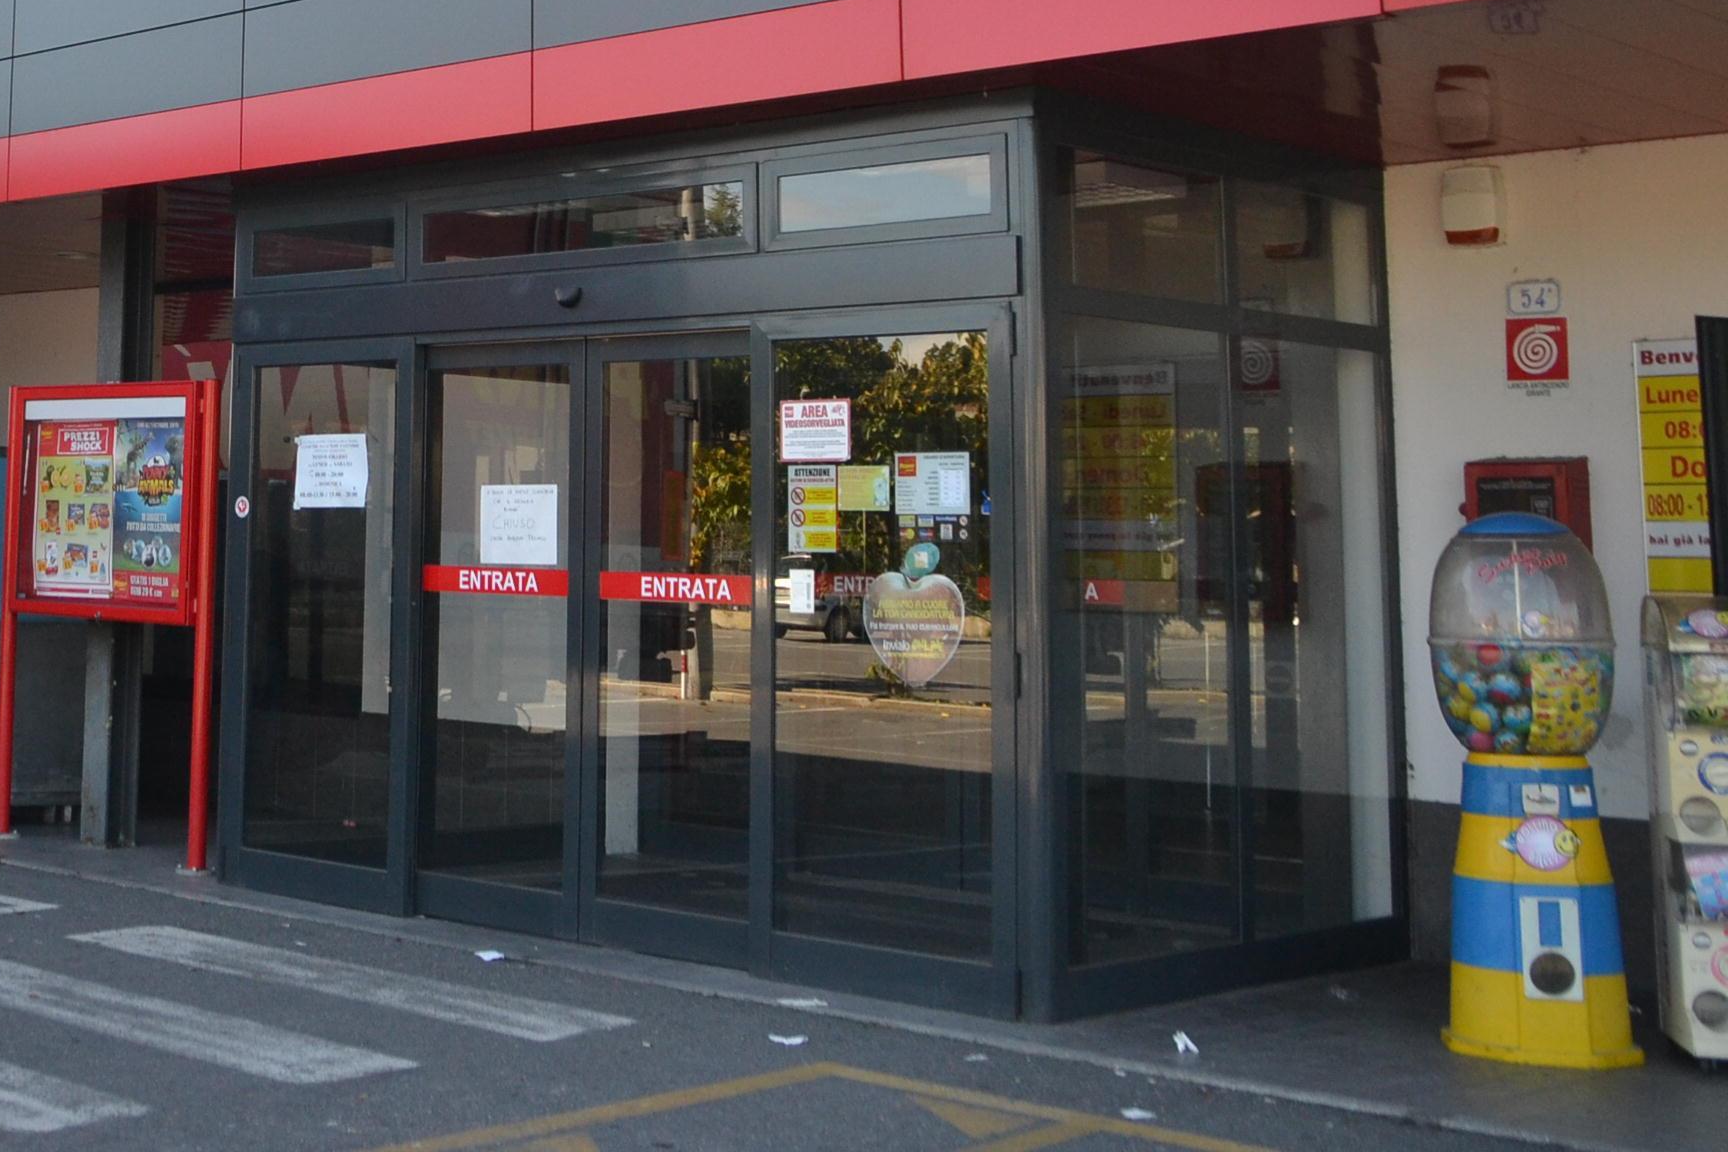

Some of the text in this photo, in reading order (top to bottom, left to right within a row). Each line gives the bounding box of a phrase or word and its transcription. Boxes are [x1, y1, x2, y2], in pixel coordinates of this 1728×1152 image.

[1640, 350, 1699, 365] Benv
[801, 405, 829, 418] AREA
[784, 419, 846, 429] VIDEOSORVEGLIATA
[64, 431, 100, 442] PREZZI
[70, 440, 102, 451] SHOCK
[794, 468, 831, 477] ATTENZIONE
[458, 570, 539, 592] ENTRATA
[640, 576, 732, 600] ENTRATA
